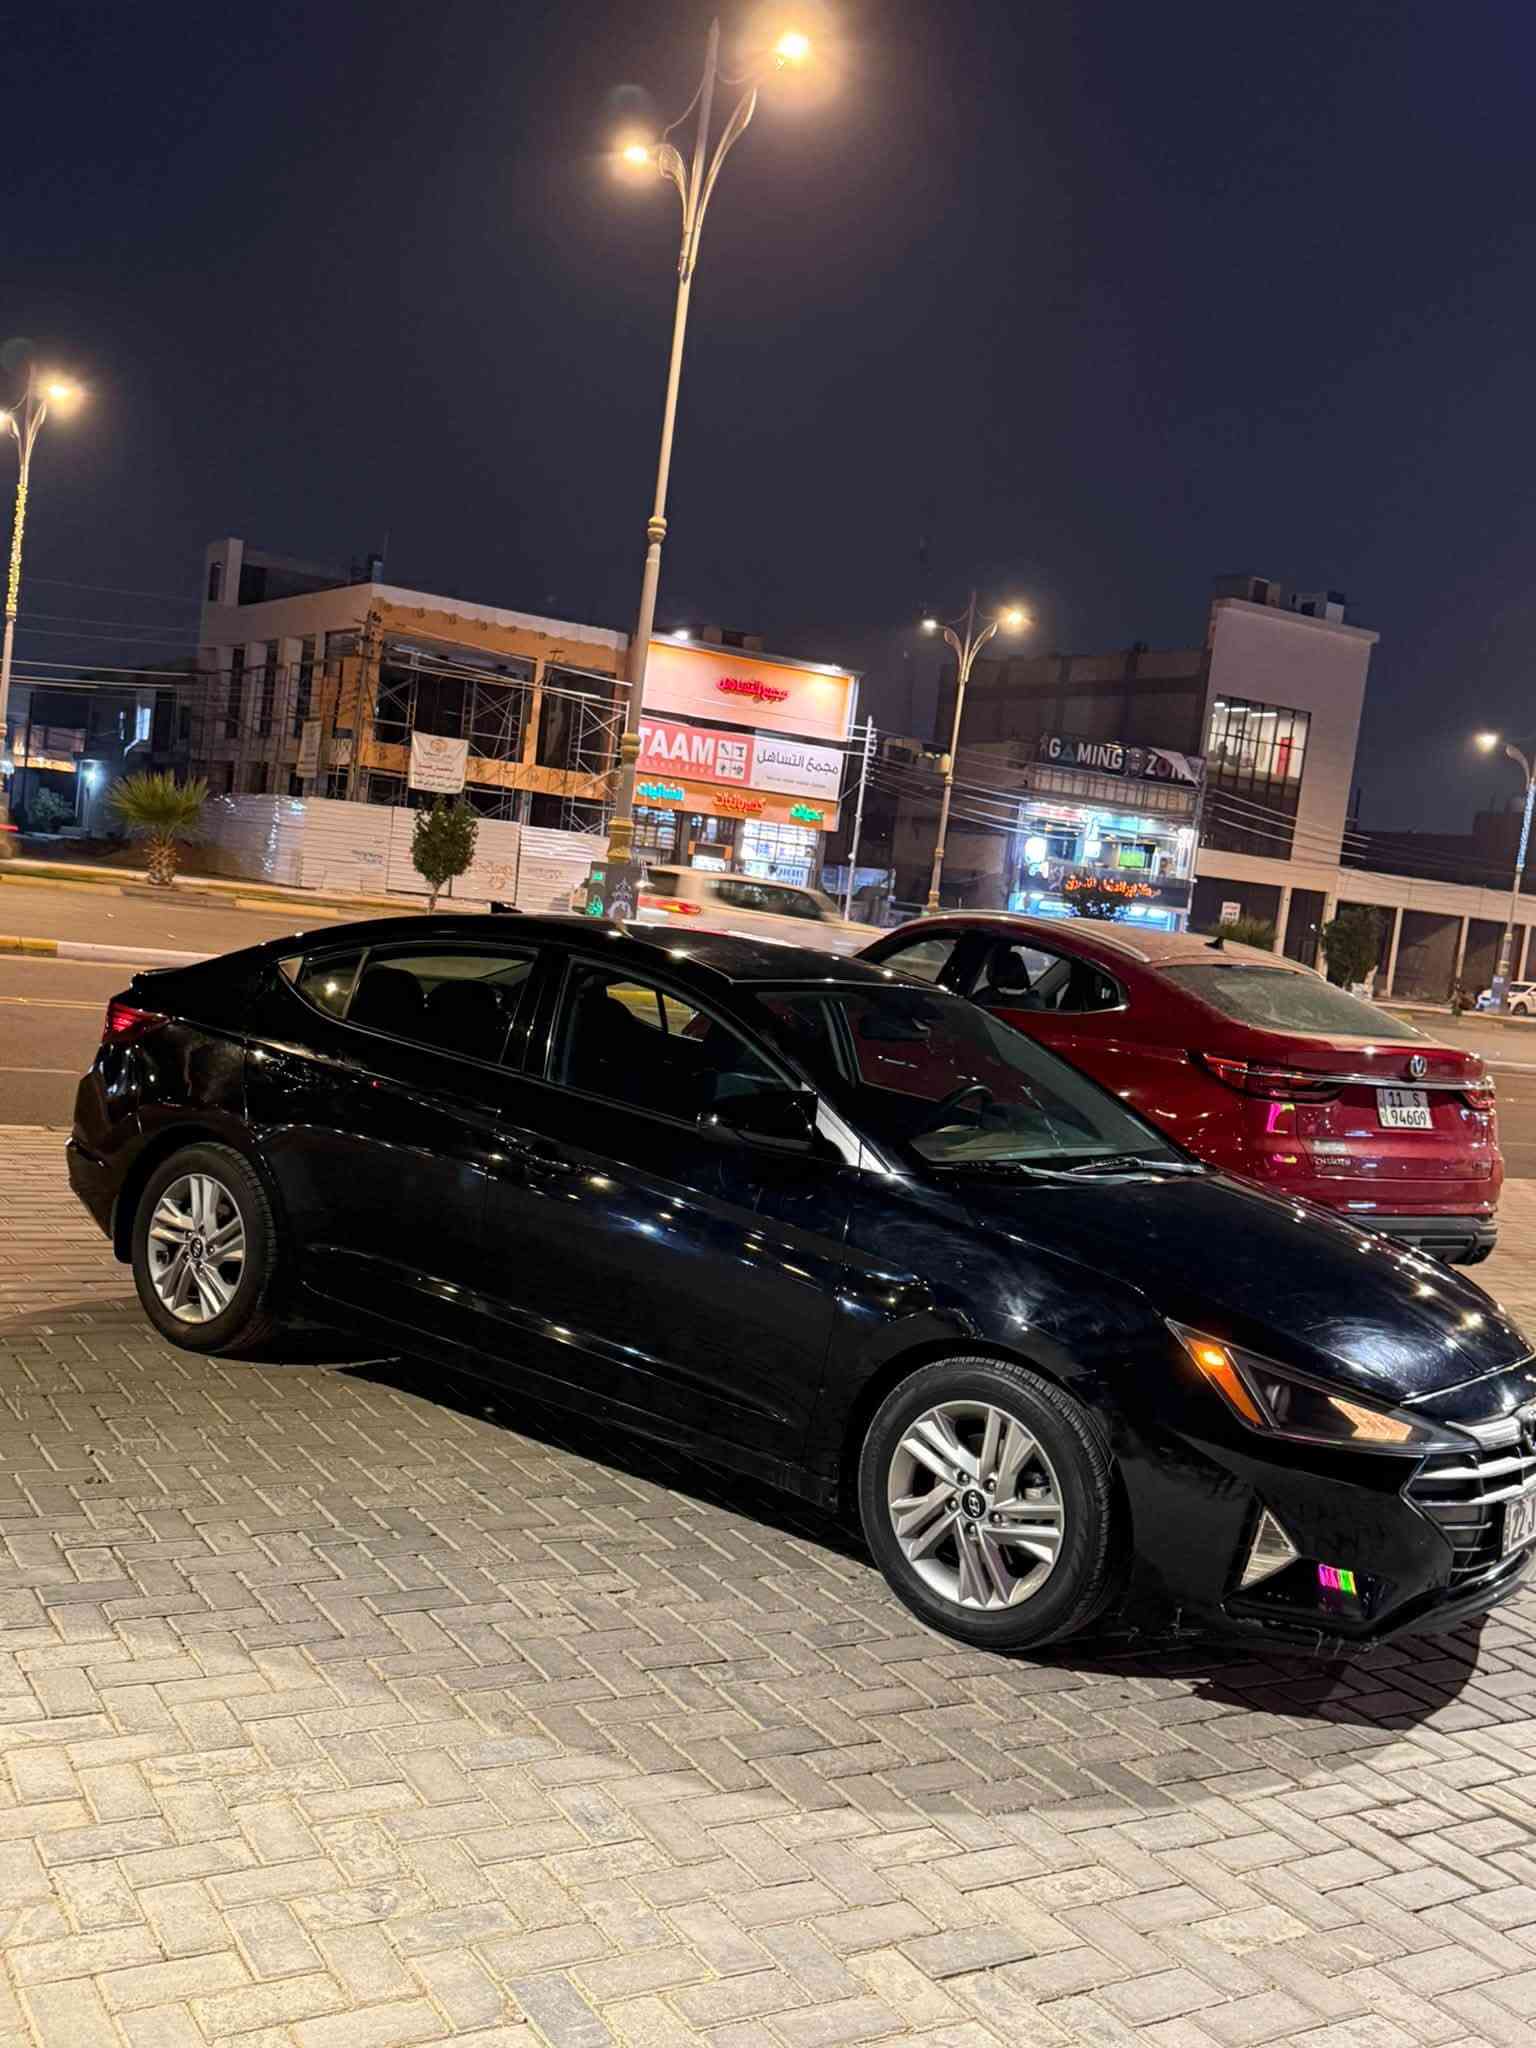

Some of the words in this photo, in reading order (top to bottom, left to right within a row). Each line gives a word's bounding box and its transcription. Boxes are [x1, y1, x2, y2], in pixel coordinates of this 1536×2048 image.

[757, 749, 805, 768] التساهل
[805, 756, 839, 775] مجمع
[1389, 1091, 1403, 1108] 11
[1413, 1092, 1421, 1108] S
